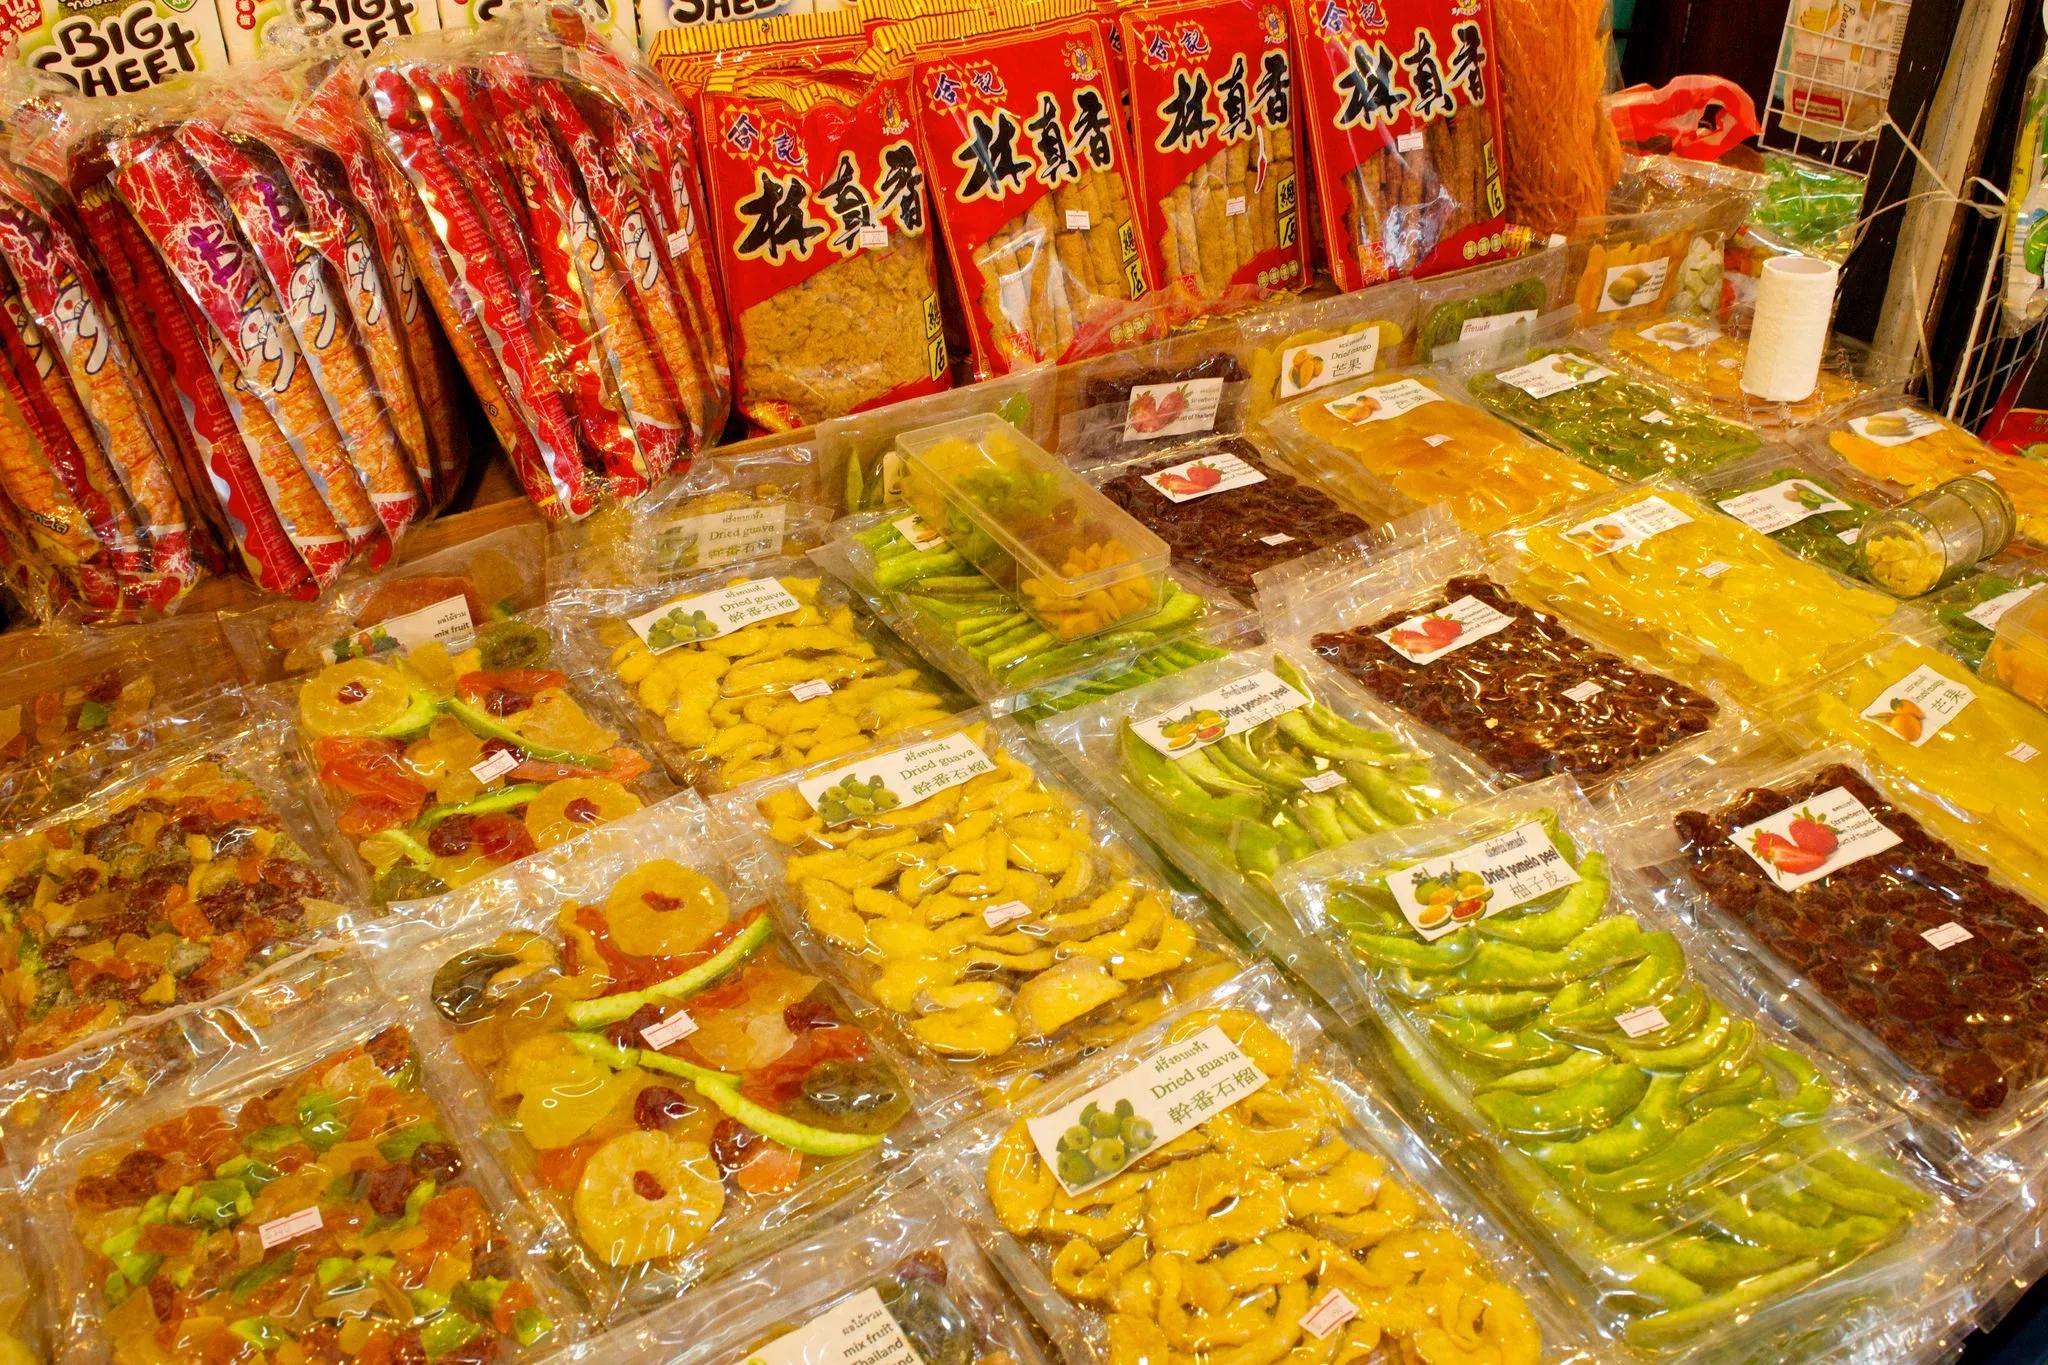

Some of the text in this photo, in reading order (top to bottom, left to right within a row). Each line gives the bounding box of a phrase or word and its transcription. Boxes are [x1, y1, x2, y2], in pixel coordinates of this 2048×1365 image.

[58, 7, 163, 67] BIG
[709, 524, 776, 541] Dried guava
[719, 591, 787, 613] Dried guava
[434, 622, 471, 639] mix fruit
[1217, 704, 1245, 719] Dried
[1269, 684, 1291, 700] peel
[899, 748, 975, 781] Dried guava
[1480, 844, 1561, 885] Dried pomelo peel
[1149, 1050, 1240, 1101] Dried guava
[842, 1309, 883, 1336] ผลไม้รวม
[843, 1322, 894, 1358] mix fruit
